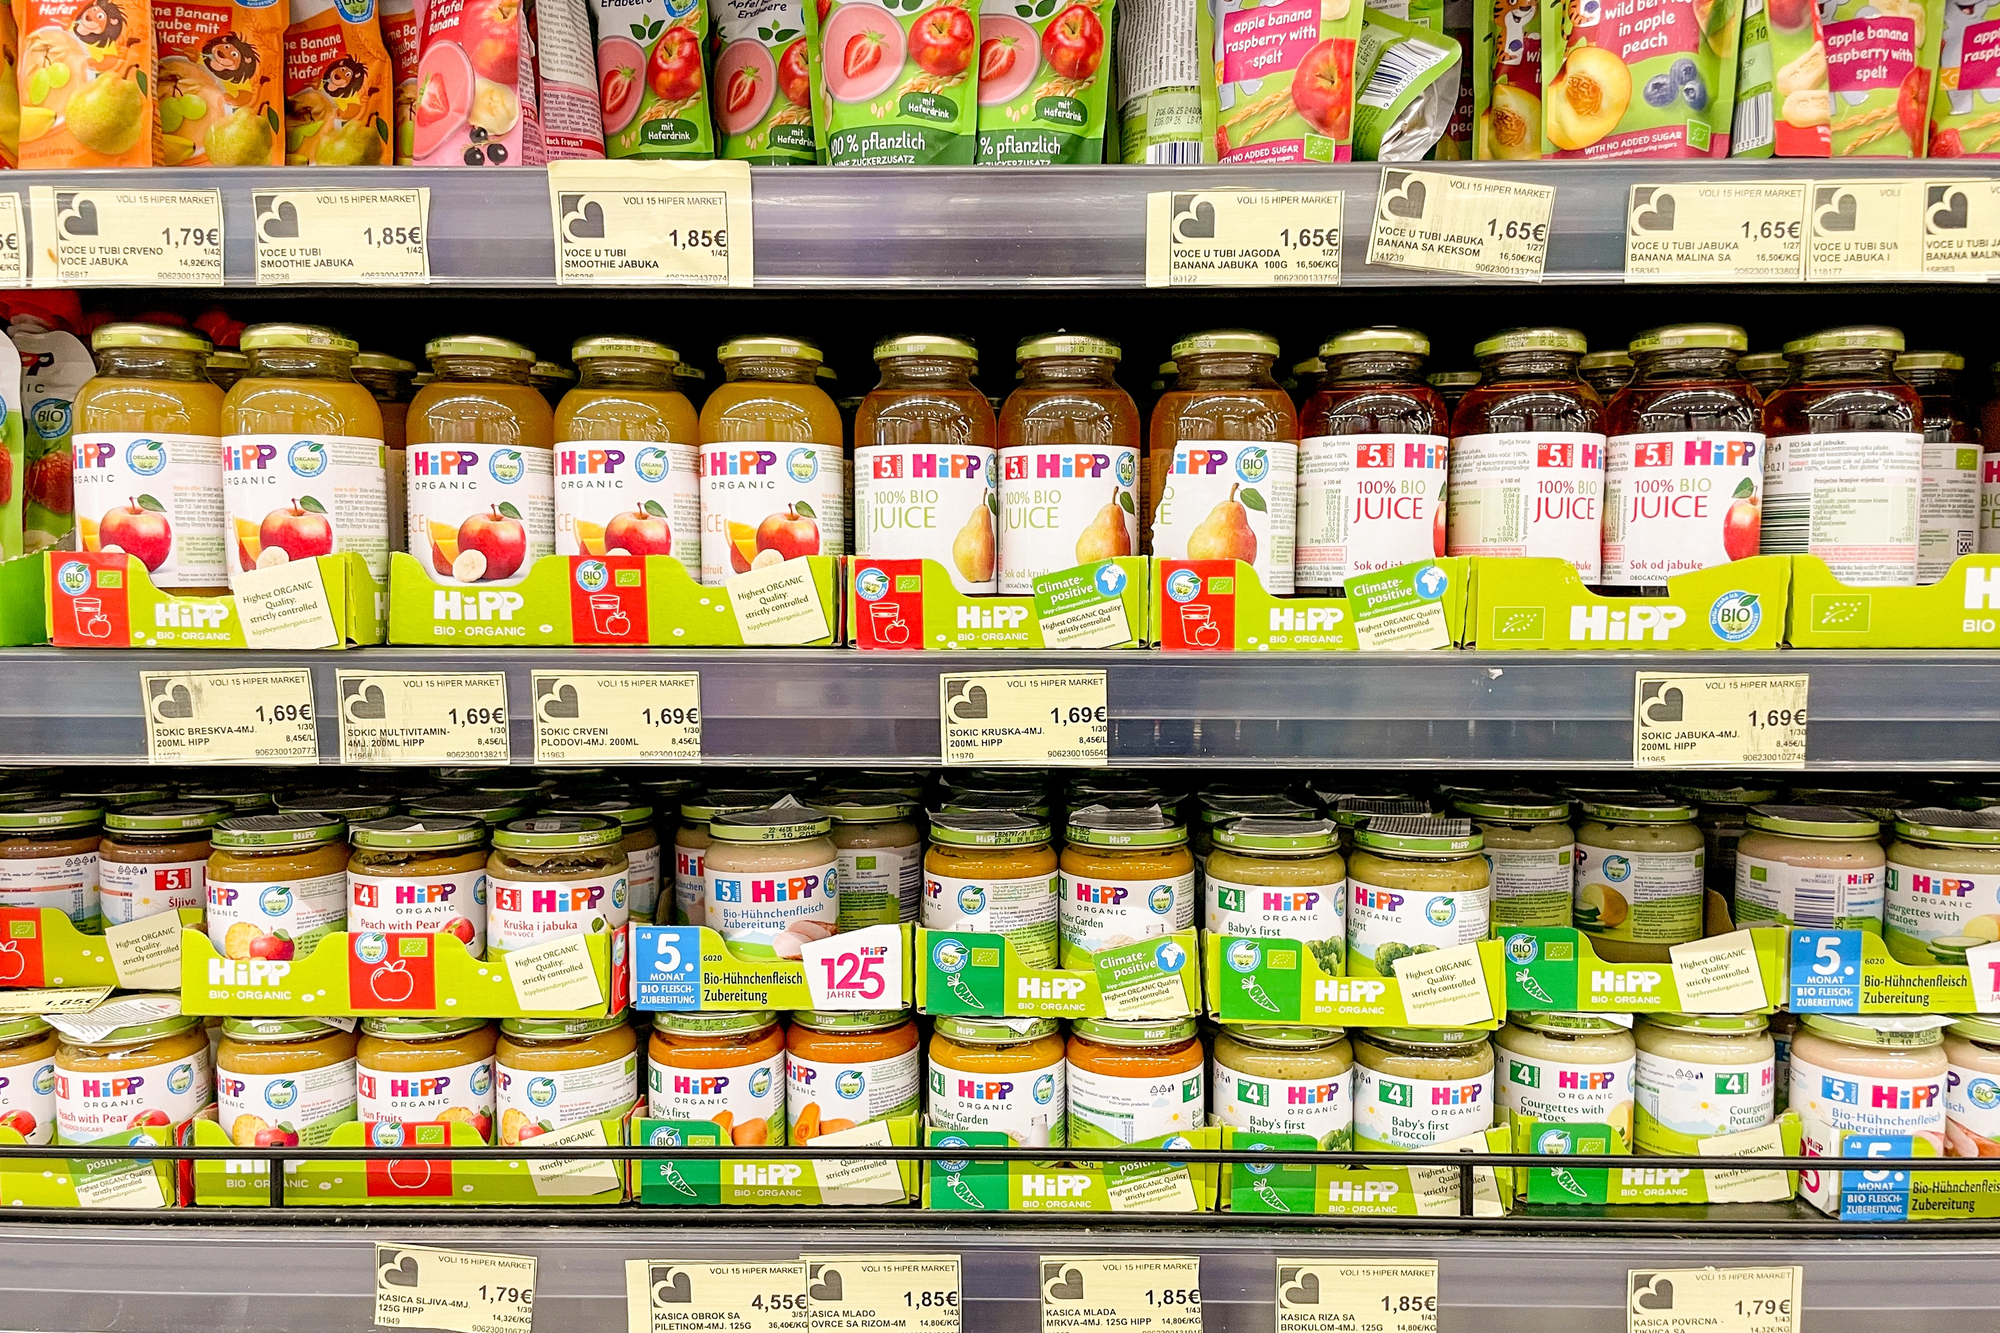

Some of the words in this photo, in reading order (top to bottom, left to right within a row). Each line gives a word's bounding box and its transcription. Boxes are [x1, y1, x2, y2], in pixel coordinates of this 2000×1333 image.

[183, 7, 228, 22] Banane
[1234, 18, 1265, 34] apple
[1268, 9, 1312, 28] banana
[196, 22, 219, 34] mit
[1619, 22, 1631, 36] in
[1634, 13, 1676, 32] apple
[1226, 34, 1287, 54] raspberry
[1289, 27, 1316, 40] with
[1828, 30, 1864, 48] apple
[1868, 26, 1908, 42] banana
[1622, 33, 1668, 58] peach
[1252, 50, 1283, 69] spelt
[661, 122, 674, 131] mit
[648, 131, 690, 140] Haferdrink
[862, 131, 926, 158] pflanzlich
[1584, 145, 1604, 156] WITH
[1606, 142, 1619, 151] NO
[1621, 136, 1650, 148] ADDED
[1652, 132, 1682, 142] SUGAR
[852, 155, 914, 166] ZUCKERZUSATZ
[116, 195, 137, 204] VOLI
[139, 196, 149, 204] 15
[150, 196, 177, 204] HIPER
[179, 196, 214, 205] MARKET
[364, 227, 420, 248] 1,85€
[1487, 218, 1546, 242] 1,65€
[1741, 221, 1800, 242] 1,65€
[161, 228, 219, 249] 1,79€
[669, 230, 726, 250] 1,85€
[1280, 229, 1339, 250] 1,65€
[61, 246, 87, 255] VOCE
[89, 246, 96, 255] U
[99, 246, 121, 255] TUBI
[124, 246, 163, 256] CRVENO
[1238, 250, 1280, 258] JAGODA
[1377, 239, 1419, 251] BANANA
[1421, 242, 1434, 252] SA
[1438, 243, 1480, 258] KEKSOM
[179, 259, 220, 268] 14,92€/KG
[564, 260, 616, 269] SMOOTHIE
[618, 260, 659, 269] JABUKA
[1173, 261, 1215, 270] BANANA
[1218, 261, 1258, 270] JABUKA
[1264, 261, 1288, 269] 100G
[1296, 261, 1338, 270] 16,50€/KG
[1630, 254, 1673, 262] BANANA
[1676, 254, 1716, 262] MALINA
[1718, 254, 1731, 262] SA
[414, 451, 478, 476] HiPP
[912, 454, 980, 478] HiPP
[416, 481, 477, 490] ORGANIC
[1357, 481, 1396, 494] 100%
[1401, 480, 1426, 494] BIO
[874, 490, 906, 504] 100%
[910, 490, 938, 504] BIO
[1354, 496, 1423, 523] JUICE
[873, 506, 937, 532] JUICE
[1630, 560, 1647, 570] Sok
[1650, 560, 1663, 570] od
[1666, 560, 1702, 571] jabuke
[243, 592, 272, 604] Highest
[274, 581, 314, 598] ORGANIC
[1036, 577, 1084, 595] Climate-
[1050, 584, 1093, 606] positive
[265, 598, 296, 610] Quality:
[434, 590, 524, 620] HiPP
[156, 604, 229, 628] HiPP
[250, 612, 276, 624] strictly
[278, 602, 318, 618] controlled
[1721, 608, 1750, 623] BIO
[434, 626, 456, 636] BIO
[464, 626, 526, 636] ORGANIC
[1570, 606, 1686, 641] HiPP
[156, 632, 174, 640] BIO
[182, 632, 230, 641] ORGANIC
[255, 704, 311, 724] 1,69€
[642, 708, 698, 728] 1,69€
[1050, 706, 1106, 726] 1,69€
[1748, 709, 1806, 730] 1,69€
[156, 728, 186, 737] SOKIC
[188, 726, 258, 735] BRESKVA-4MJ.
[380, 728, 450, 737] MULTIVITAMIN-
[541, 728, 570, 736] SOKIC
[572, 728, 608, 736] CRVENI
[950, 729, 979, 737] SOKIC
[981, 727, 1045, 736] KRUSKA-4MJ.
[1674, 730, 1740, 740] JABUKA-4MJ.
[157, 738, 186, 747] 200ML
[188, 738, 210, 746] HIPP
[541, 738, 607, 746] PLODOVI-4MJ.
[610, 738, 639, 746] 200ML
[752, 876, 820, 903] HiPP
[1077, 883, 1128, 905] HiPP
[168, 896, 197, 908] Šljive
[532, 886, 605, 912] HiPP
[1263, 892, 1319, 911] HiPP
[723, 902, 824, 919] Bio-Hühnchenfleisch
[360, 919, 384, 930] Peach
[389, 919, 413, 930] with
[416, 919, 441, 930] Pear
[504, 919, 534, 931] Kruška
[537, 921, 540, 931] i
[541, 920, 578, 932] jabuka
[1228, 922, 1256, 936] Baby's
[1259, 926, 1281, 936] first
[642, 932, 652, 940] AB
[654, 933, 694, 972] 5.
[704, 954, 722, 962] 6020
[860, 946, 888, 955] HiPP
[208, 959, 290, 986] HiPP
[650, 973, 685, 981] MONAT
[704, 972, 802, 986] Bio-Hühnchenfleisch
[821, 952, 886, 1000] 125
[1864, 974, 1967, 988] Bio-Hühnchenfleisch
[641, 985, 659, 994] BIO
[661, 984, 694, 994] FLEISCH-
[704, 989, 768, 1004] Zubereitung
[827, 991, 856, 999] JAHRE
[641, 995, 695, 1004] ZUBEREITUNG
[1864, 991, 1929, 1006] Zubereitung
[83, 1076, 144, 1098] HiPP
[1872, 1085, 1939, 1109] HiPP
[1520, 1096, 1578, 1115] Courgettes
[1581, 1104, 1604, 1114] with
[78, 1111, 99, 1123] with
[102, 1113, 128, 1123] Pear
[956, 1113, 988, 1126] Garden
[1520, 1106, 1566, 1123] Potatoes
[1392, 1128, 1436, 1141] Broccoli
[734, 1164, 802, 1185] HiPP
[379, 1294, 414, 1304] KASICA
[416, 1296, 471, 1309] SLJIVA-4MJ.
[479, 1285, 532, 1304] 1,79€
[1145, 1289, 1200, 1308] 1,85€
[752, 1294, 807, 1311] 4,55€
[1381, 1296, 1436, 1314] 1,85€
[1734, 1299, 1790, 1318] 1,79€
[654, 1312, 689, 1320] KASICA
[691, 1312, 725, 1320] OBROK
[727, 1312, 740, 1320] SA
[1083, 1308, 1116, 1316] MLADA
[1318, 1313, 1340, 1322] RIZA
[1342, 1313, 1355, 1322] SA
[654, 1322, 727, 1331] PILETINOM-4MJ.
[729, 1322, 751, 1330] 125G
[1046, 1318, 1102, 1327] MRKVA-4MJ.
[1106, 1318, 1128, 1326] 125G
[1280, 1323, 1358, 1332] BROKULOM-4MJ.
[1672, 1317, 1718, 1326] POVRCNA
